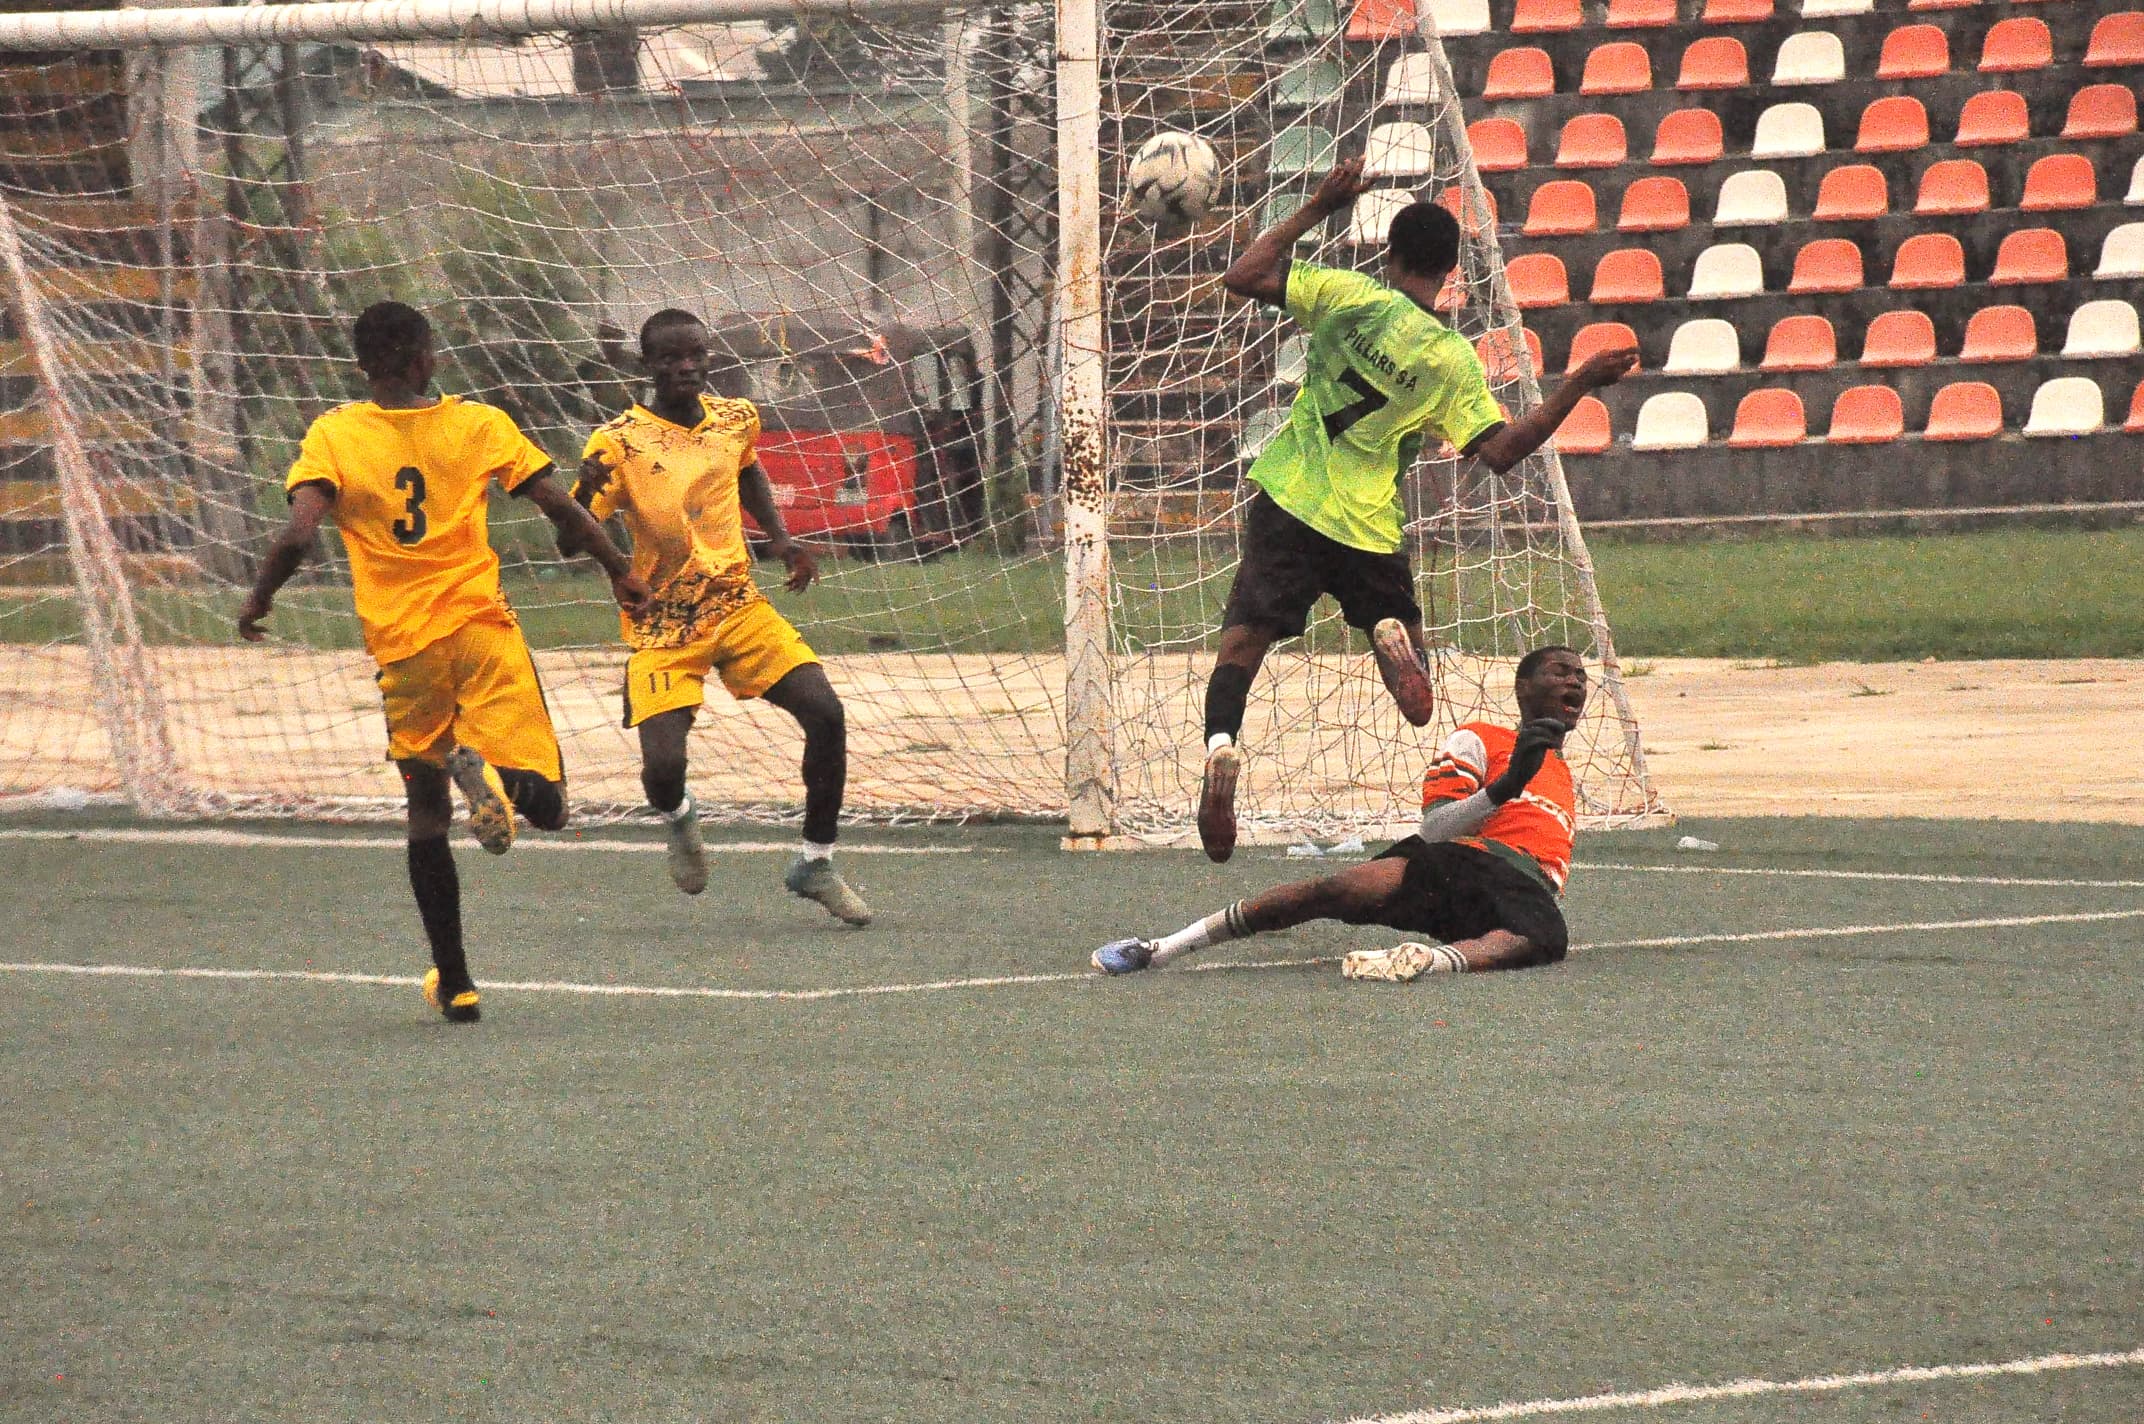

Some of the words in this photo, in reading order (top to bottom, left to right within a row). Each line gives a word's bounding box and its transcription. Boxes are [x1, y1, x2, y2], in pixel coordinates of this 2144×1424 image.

[1343, 327, 1397, 376] PILLARS
[1322, 366, 1390, 444] 7
[393, 466, 427, 545] 3
[649, 671, 671, 694] 11
